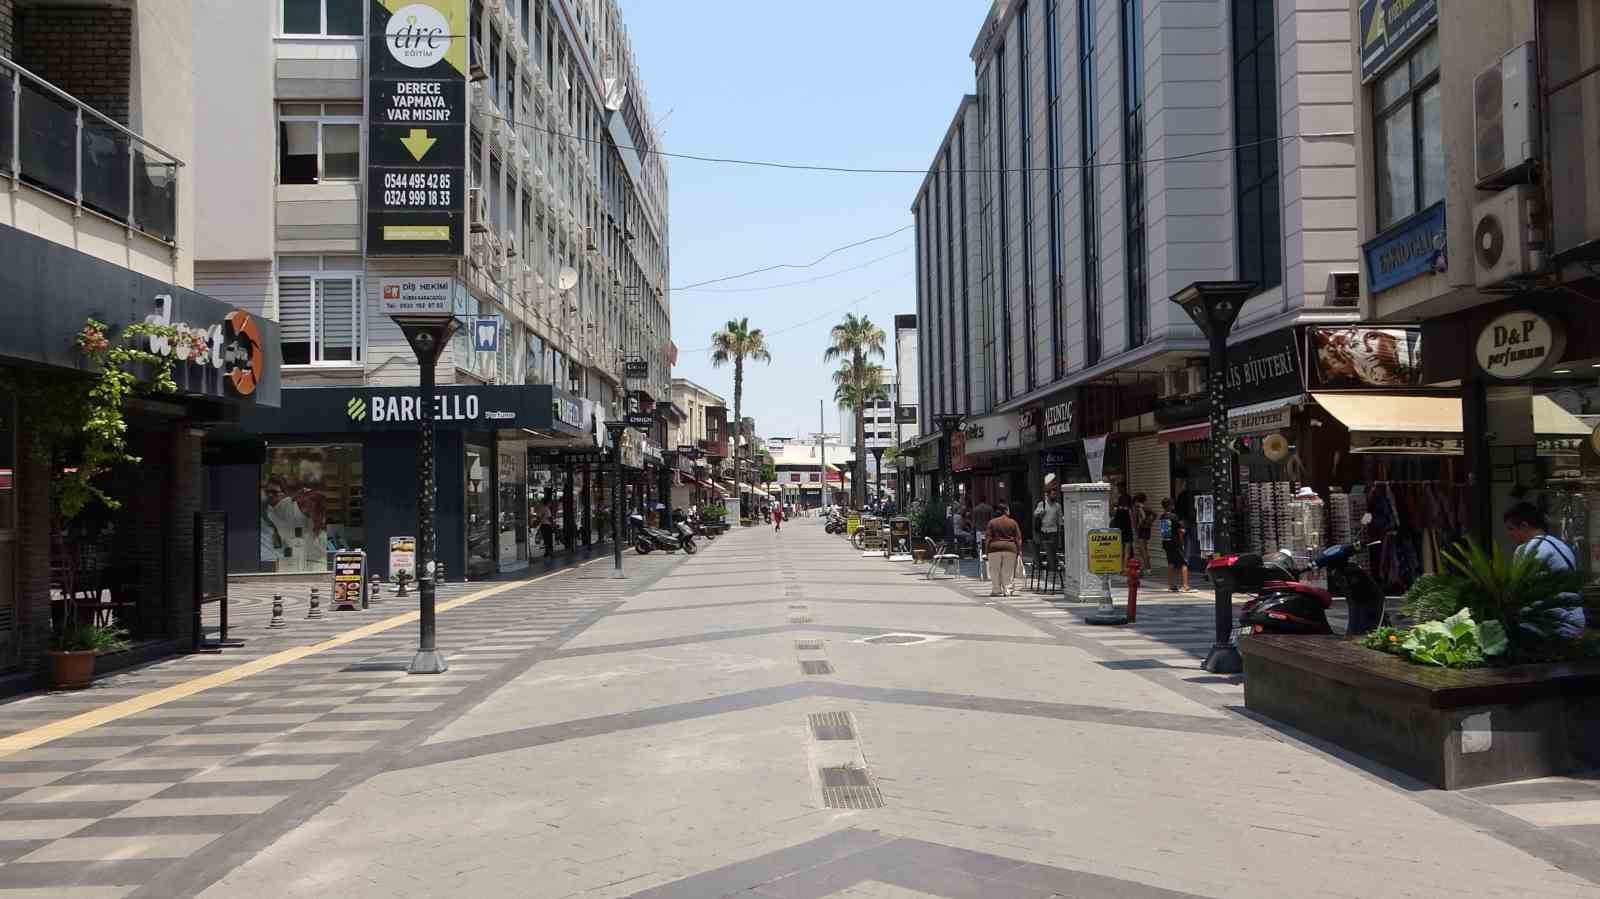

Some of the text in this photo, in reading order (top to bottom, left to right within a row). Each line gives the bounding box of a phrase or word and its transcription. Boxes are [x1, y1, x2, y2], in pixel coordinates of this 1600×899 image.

[397, 82, 441, 95] DERECE
[392, 95, 446, 108] YAPMAYA
[387, 109, 451, 121] VAR MISIN?
[384, 173, 451, 189] 0544 495 42 85
[384, 190, 451, 206] 0324 999 18 33
[402, 282, 416, 291] DİŞ
[1493, 319, 1536, 348] D&P
[1243, 345, 1294, 386] BİJUTERİ
[1091, 534, 1118, 543] UZMAN
